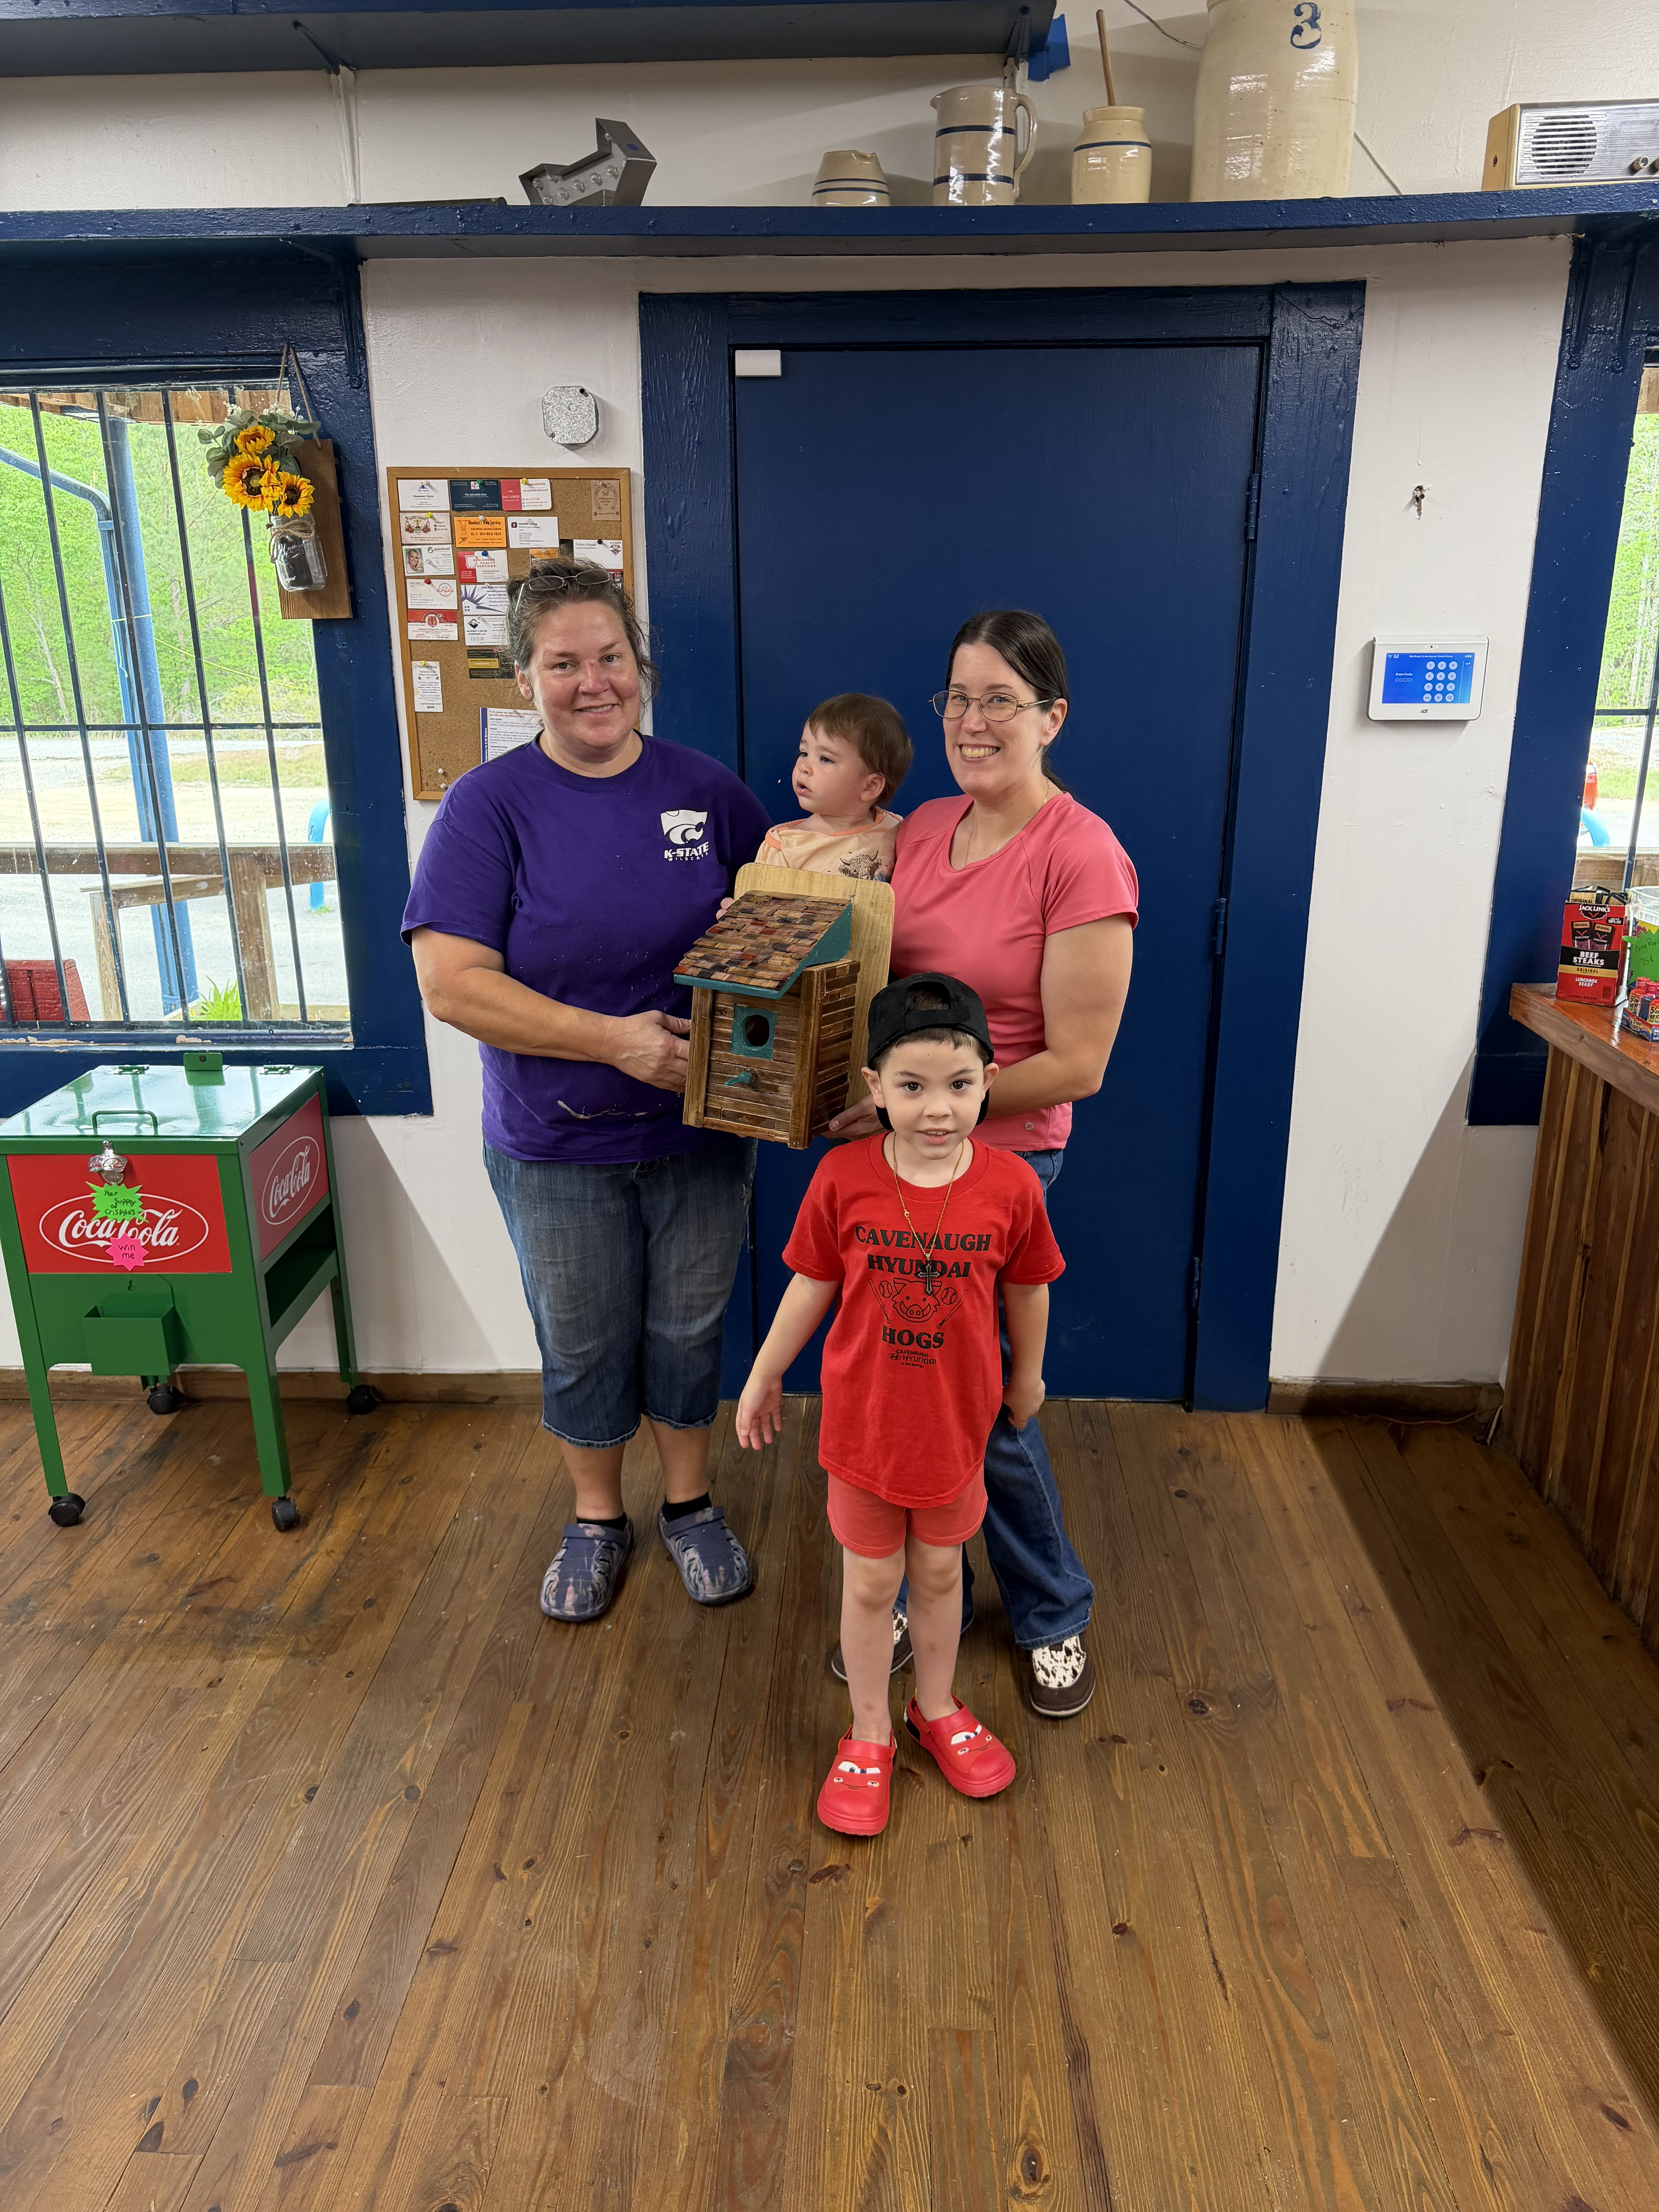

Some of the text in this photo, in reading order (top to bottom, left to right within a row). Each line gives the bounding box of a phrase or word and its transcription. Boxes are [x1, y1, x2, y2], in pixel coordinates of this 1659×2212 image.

[1290, 2, 1322, 49] 3
[664, 842, 709, 859] K-STATE
[668, 852, 708, 862] WILDCATS
[1593, 904, 1611, 913] LINK'S
[1573, 957, 1604, 965] STEAKS
[270, 1143, 311, 1218] Coca-Cola
[114, 1198, 136, 1207] Supply
[59, 1209, 184, 1248] CocaCola
[855, 1225, 991, 1252] CAVENAUGH
[867, 1254, 971, 1278] HYUNDAI
[882, 1324, 944, 1349] HOGS
[896, 1349, 929, 1358] CAVENAUGH
[903, 1355, 936, 1365] HYUNDAI
